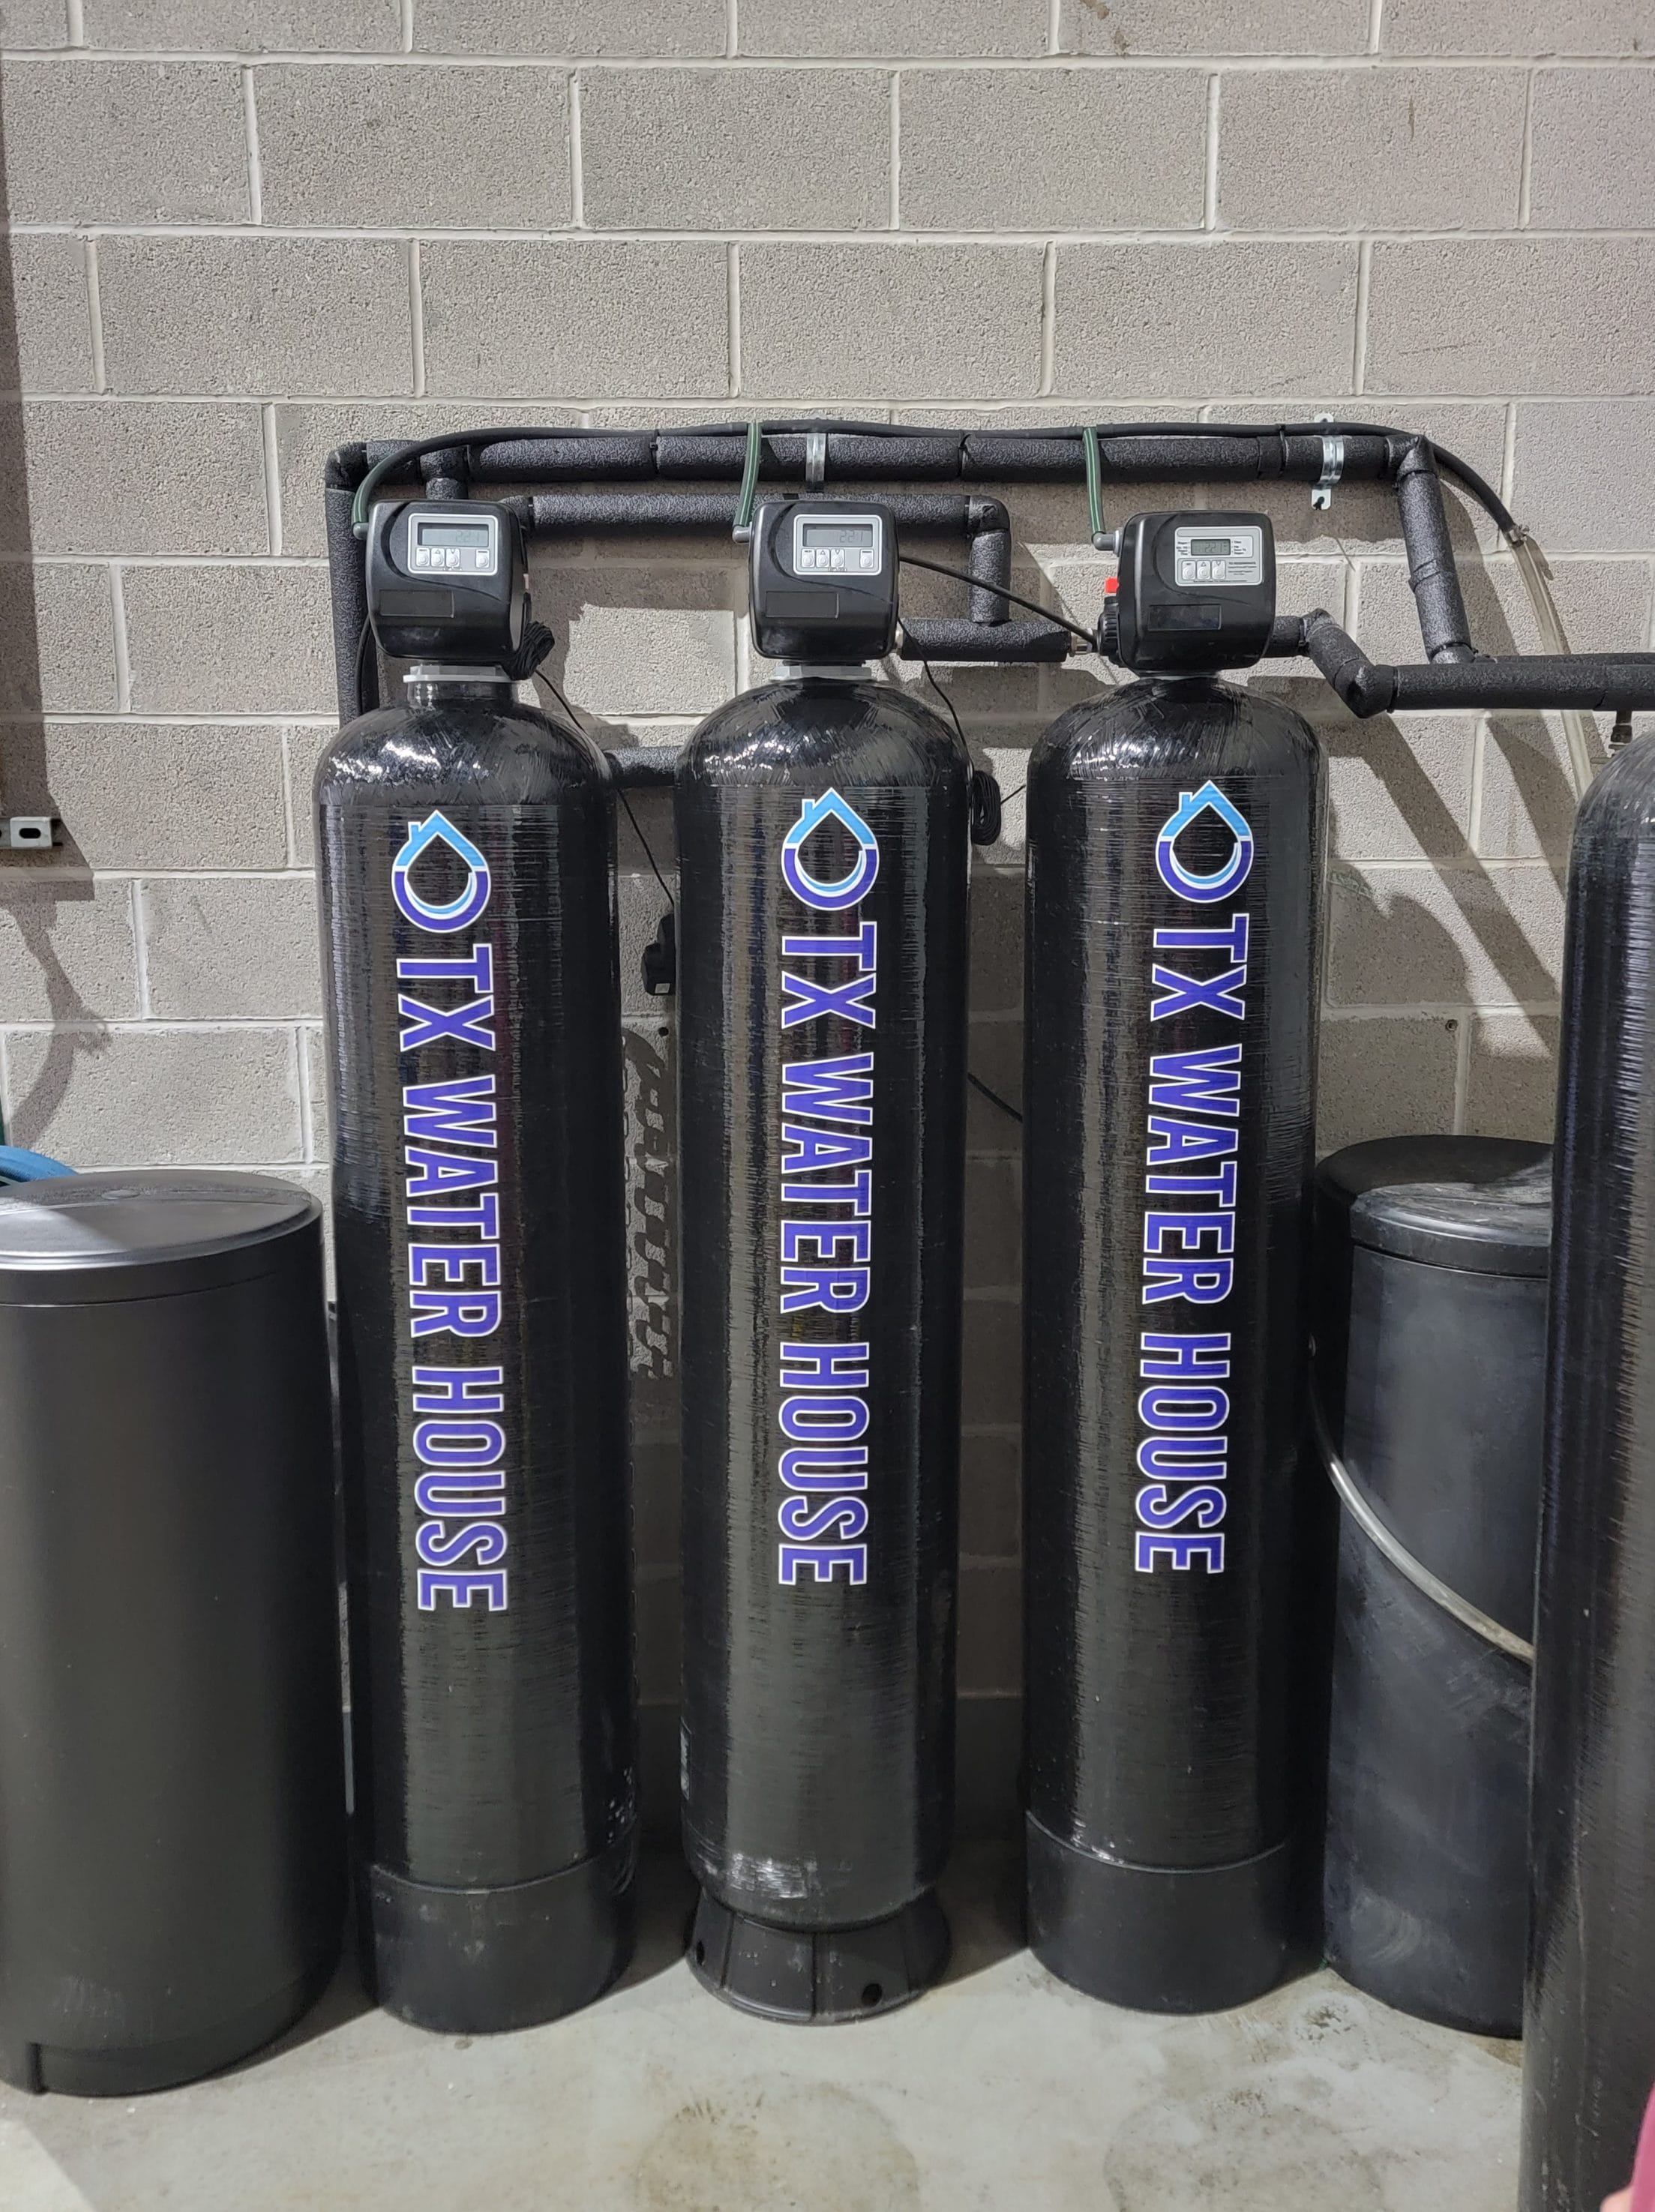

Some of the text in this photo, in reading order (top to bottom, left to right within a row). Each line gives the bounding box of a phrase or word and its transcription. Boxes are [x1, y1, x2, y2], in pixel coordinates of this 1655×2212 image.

[396, 943, 508, 1611] TX WATER HOUSE
[778, 921, 877, 1592] TX WATER HOUSE
[1135, 913, 1249, 1574] TX WATER HOUSE
